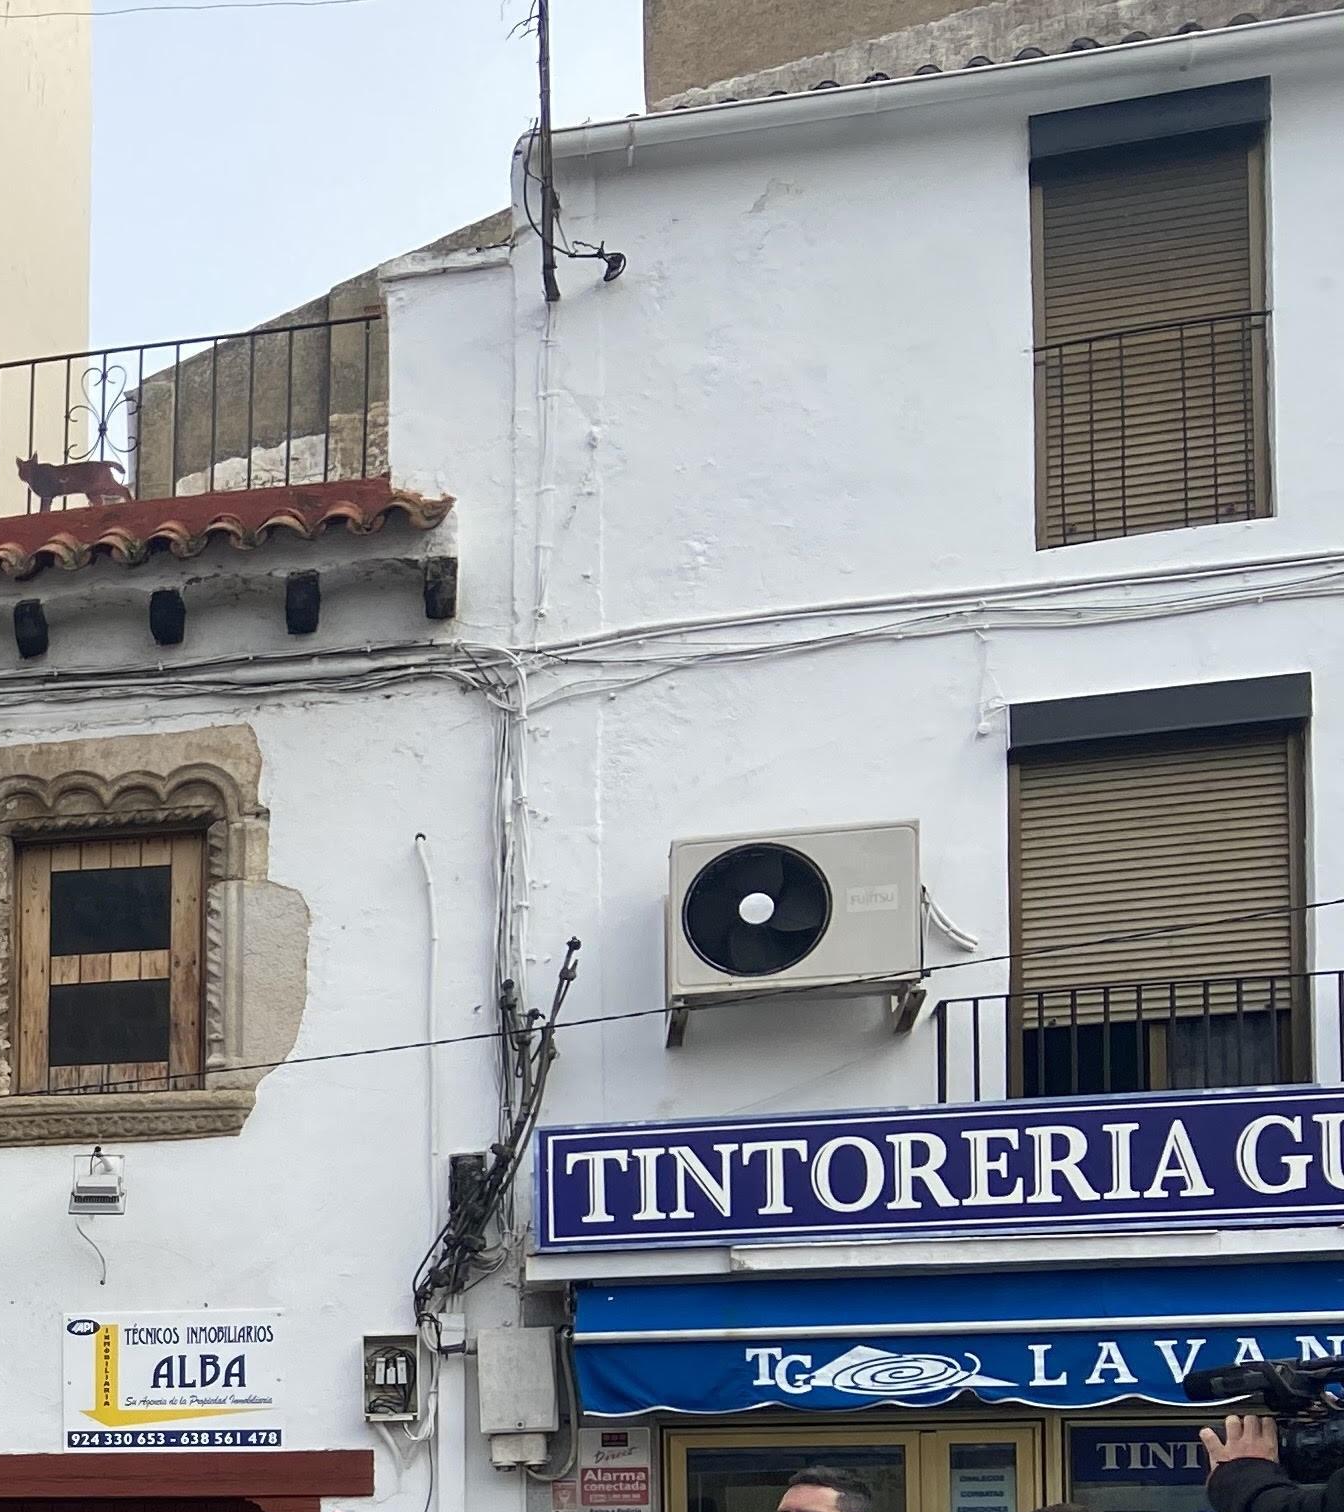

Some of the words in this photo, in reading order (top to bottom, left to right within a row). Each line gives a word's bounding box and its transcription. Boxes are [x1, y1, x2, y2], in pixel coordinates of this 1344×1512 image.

[565, 1119, 1215, 1225] TINTORERIA
[124, 1324, 180, 1345] TÉCNICOS
[186, 1325, 274, 1344] INMOBILIARIOS
[103, 1328, 111, 1407] INMOBILIARIA
[151, 1354, 247, 1389] ALBA
[746, 1347, 813, 1394] TG
[124, 1396, 137, 1407] Su
[168, 1396, 178, 1406] de
[71, 1433, 100, 1446] 924
[104, 1433, 132, 1446] 330
[137, 1433, 166, 1446] 653
[180, 1432, 210, 1445] 638
[215, 1432, 242, 1445] 561
[247, 1431, 278, 1445] 478
[1096, 1441, 1204, 1470] TINT
[583, 1468, 646, 1481] Alarma
[583, 1481, 647, 1492] conectada
